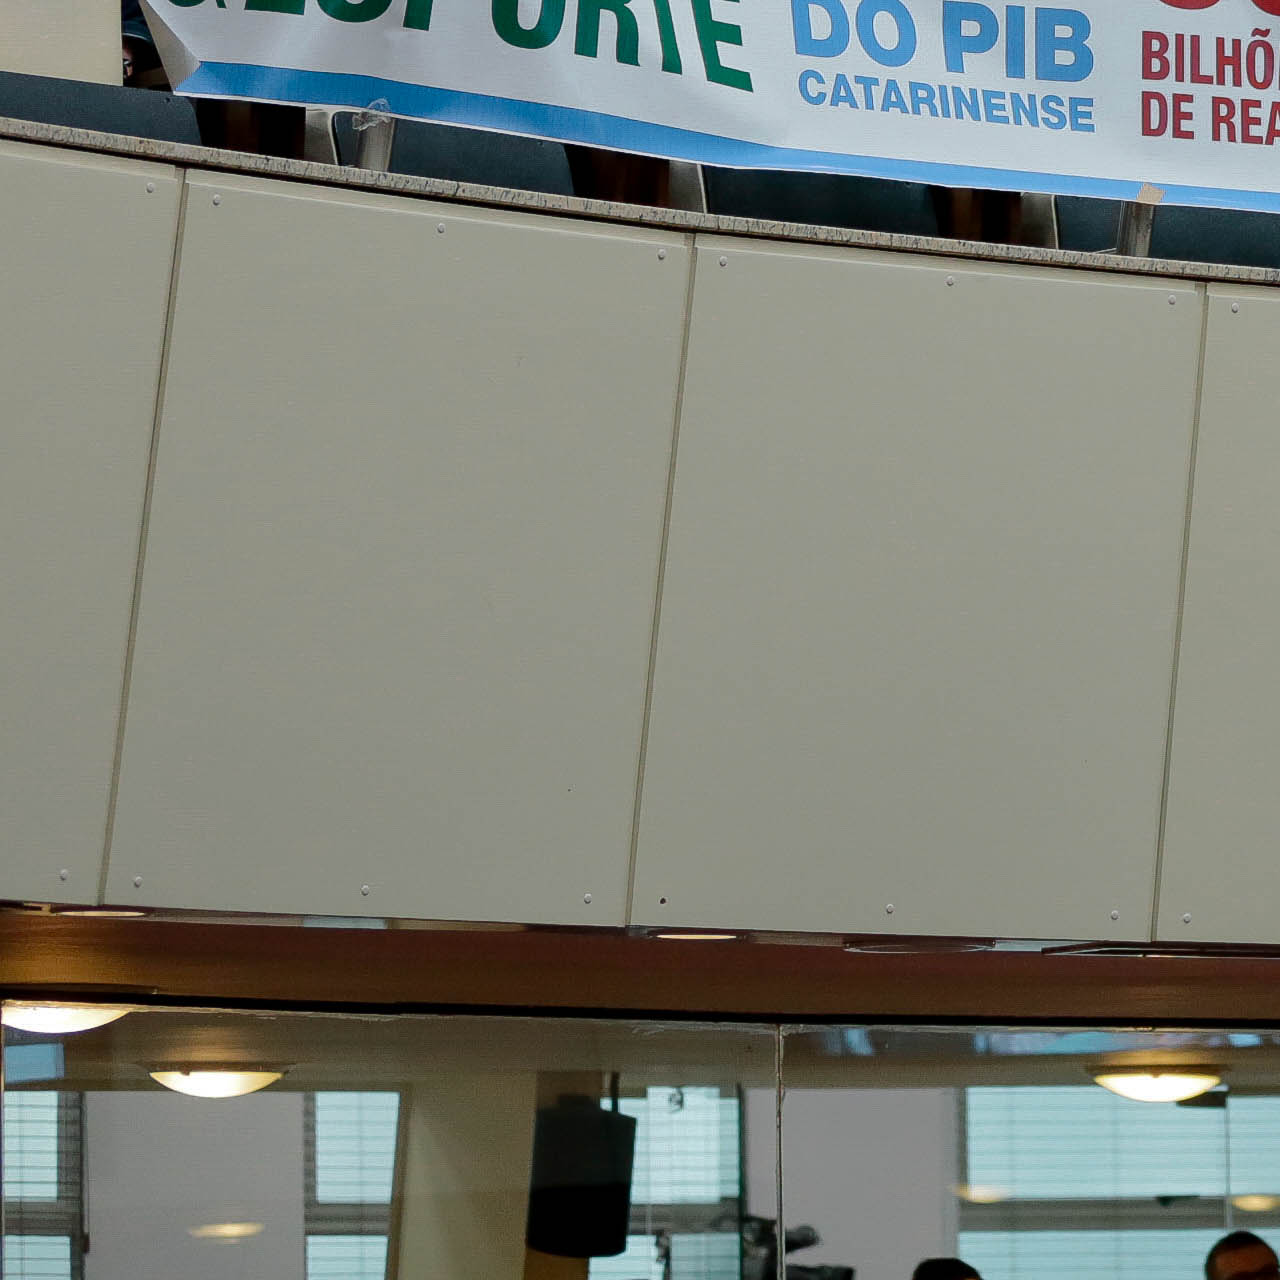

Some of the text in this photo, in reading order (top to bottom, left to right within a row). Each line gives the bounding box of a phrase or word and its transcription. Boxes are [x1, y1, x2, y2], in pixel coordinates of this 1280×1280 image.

[942, 0, 1095, 83] PIB
[799, 69, 1097, 133] CATARINENSE
[1141, 90, 1195, 141] DE
